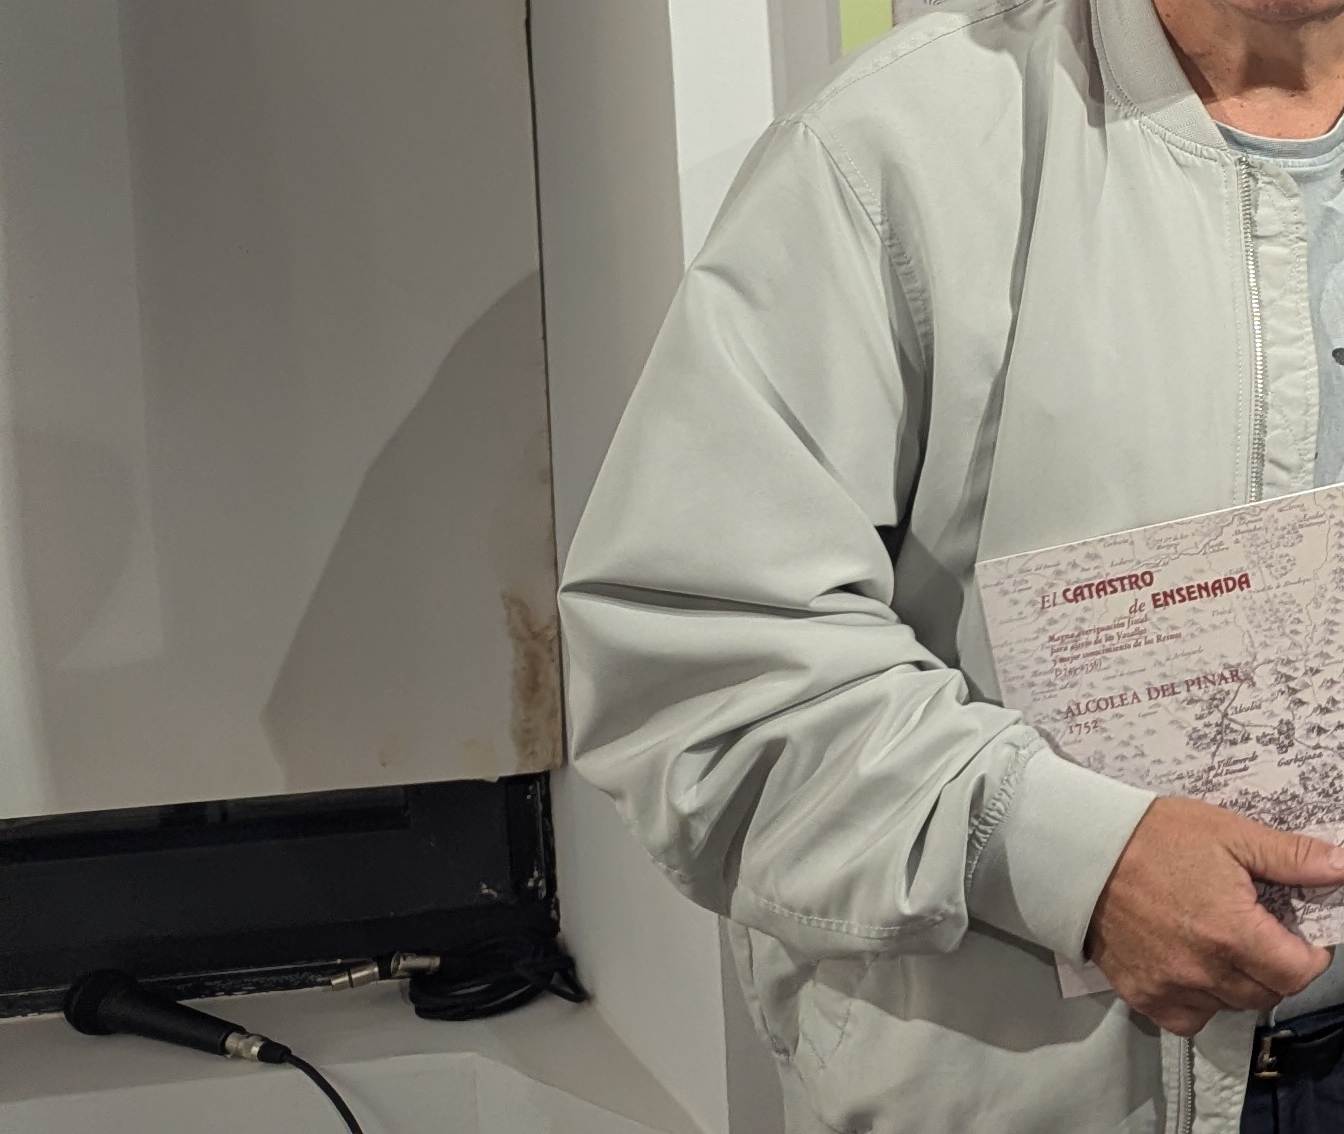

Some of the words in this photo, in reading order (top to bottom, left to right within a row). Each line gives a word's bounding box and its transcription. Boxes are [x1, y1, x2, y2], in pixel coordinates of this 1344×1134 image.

[1040, 593, 1057, 610] El
[1062, 570, 1154, 604] CATASTRO
[1128, 598, 1146, 615] de
[1151, 572, 1251, 609] ENSENADA
[1064, 691, 1141, 719] ALCOLEA
[1146, 682, 1181, 701] DEL
[1184, 669, 1243, 693] PINAR
[1068, 719, 1099, 735] 1752
